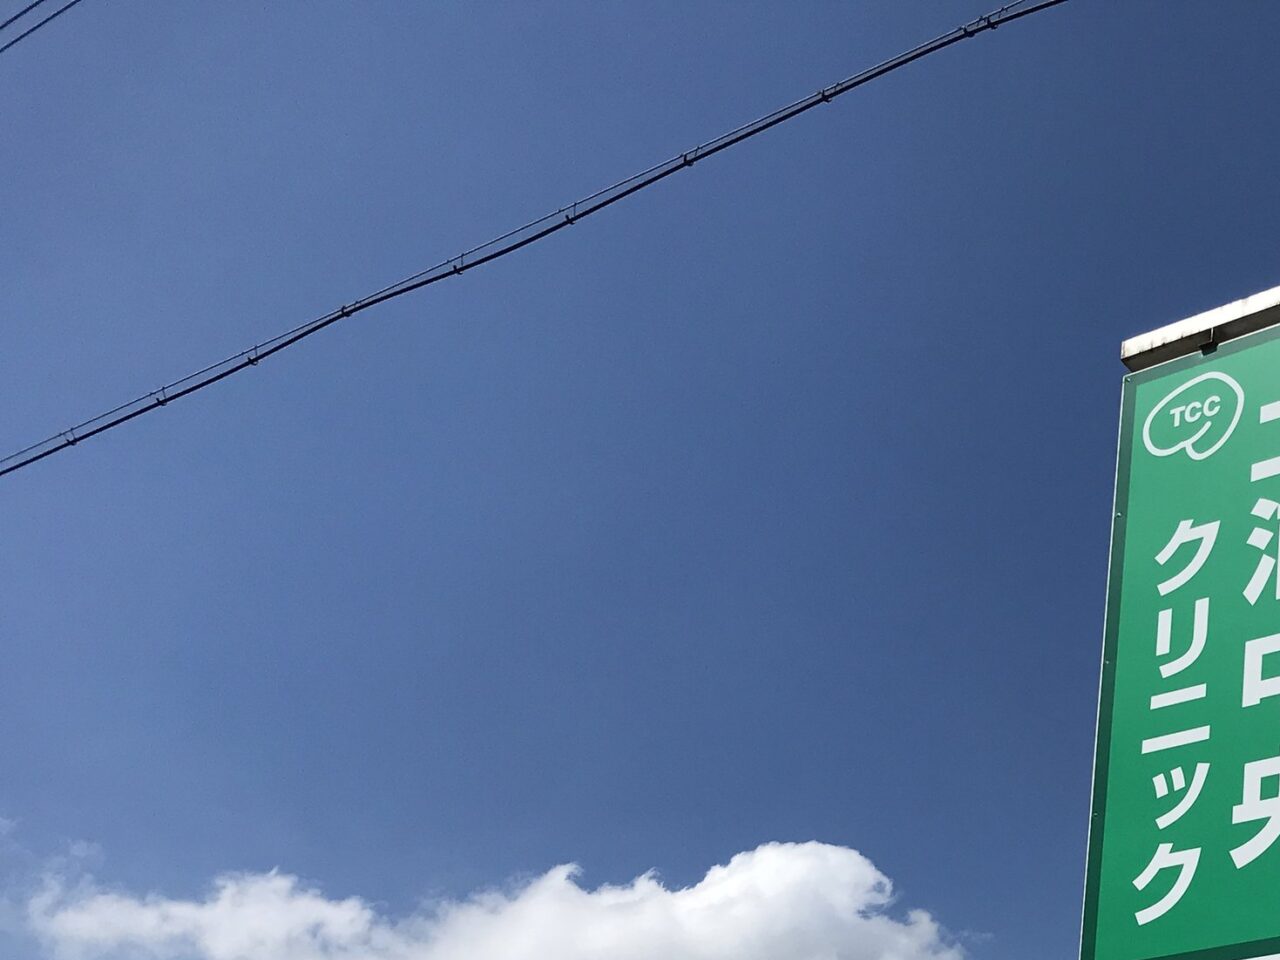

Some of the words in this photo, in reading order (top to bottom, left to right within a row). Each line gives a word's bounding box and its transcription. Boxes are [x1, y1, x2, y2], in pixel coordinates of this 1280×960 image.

[1169, 395, 1222, 428] TCC
[1132, 519, 1221, 926] クリニック
